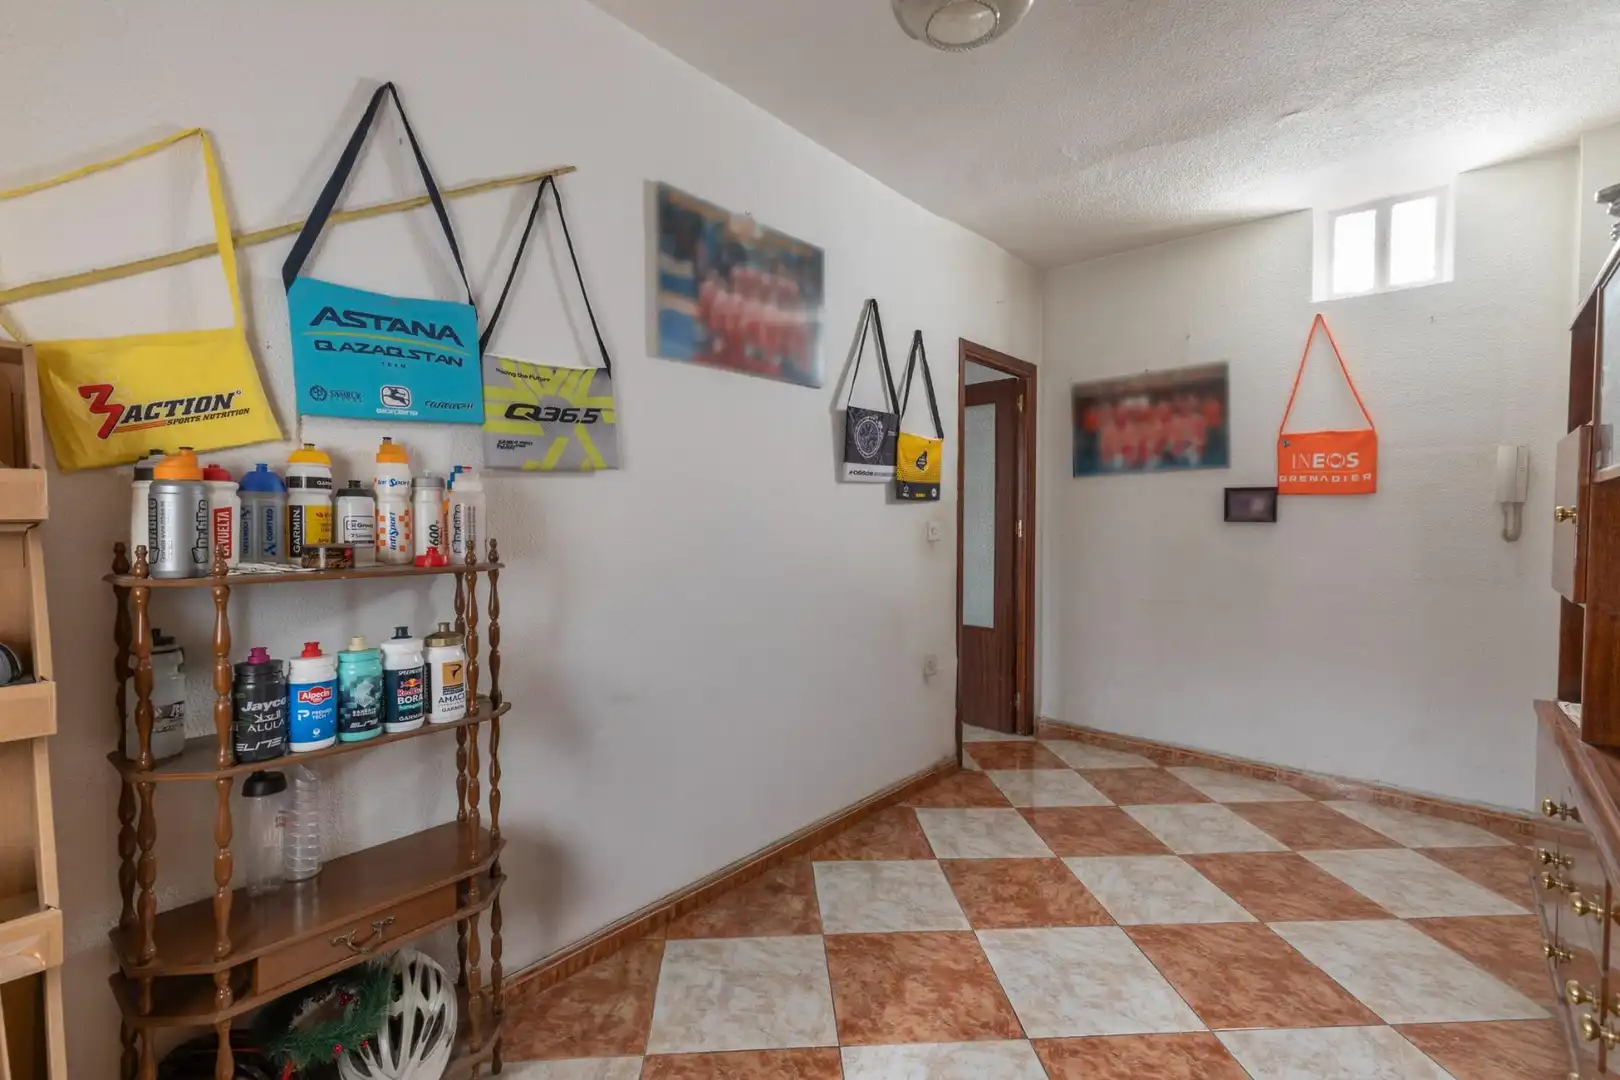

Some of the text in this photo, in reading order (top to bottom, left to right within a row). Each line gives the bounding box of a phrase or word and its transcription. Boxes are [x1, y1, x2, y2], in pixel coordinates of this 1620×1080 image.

[309, 306, 464, 347] ASTANA
[313, 340, 463, 368] QAZAQSTAN
[166, 408, 251, 426] SPORTS NUTRITION
[504, 403, 602, 424] Q36.5
[1292, 452, 1360, 469] INEOS
[1279, 473, 1372, 483] GRENADIER
[217, 511, 230, 545] VUELTA
[301, 690, 331, 701] Alpecin
[397, 693, 423, 705] BORA
[241, 697, 287, 712] Jayco
[247, 719, 285, 733] ALULA
